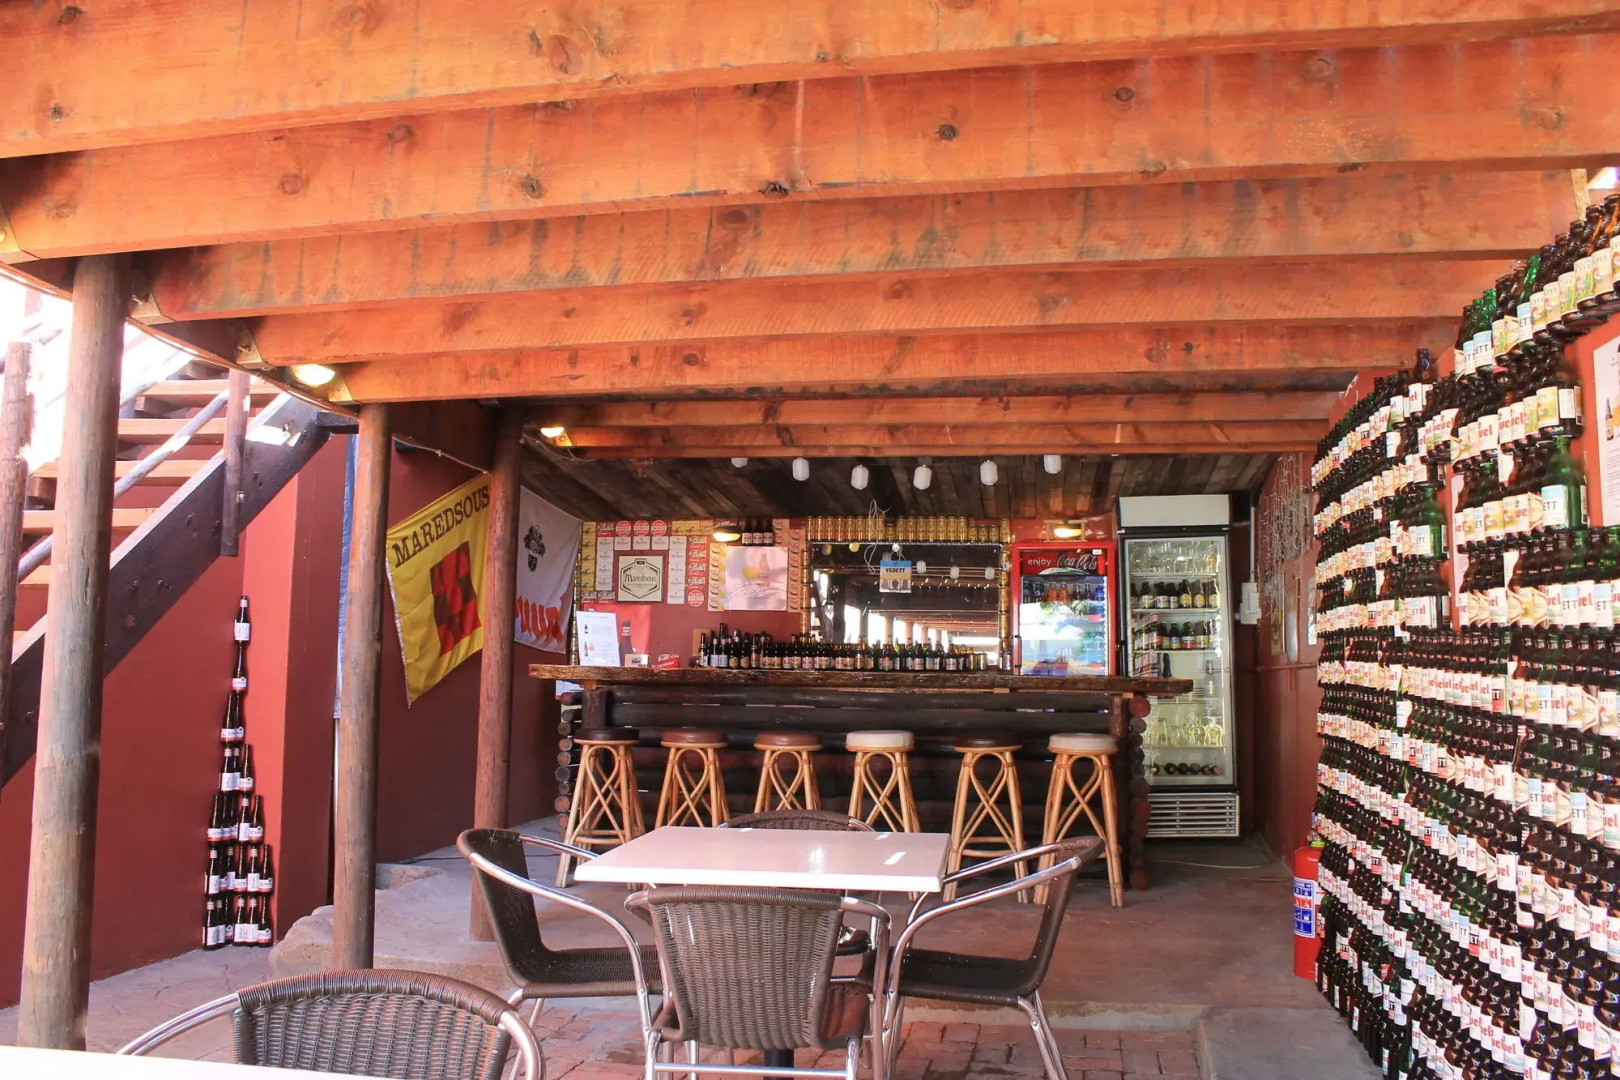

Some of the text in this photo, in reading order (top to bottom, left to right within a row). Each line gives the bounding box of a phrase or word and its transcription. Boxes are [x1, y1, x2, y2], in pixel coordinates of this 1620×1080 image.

[1479, 424, 1492, 437] vel
[1542, 500, 1557, 511] ETT
[392, 485, 490, 568] MAREDSOUS
[1028, 558, 1051, 566] enjoy
[1547, 593, 1561, 606] vel
[1562, 600, 1577, 610] ETT
[1497, 865, 1510, 877] vel
[1590, 920, 1607, 935] vel
[1500, 956, 1515, 967] vel
